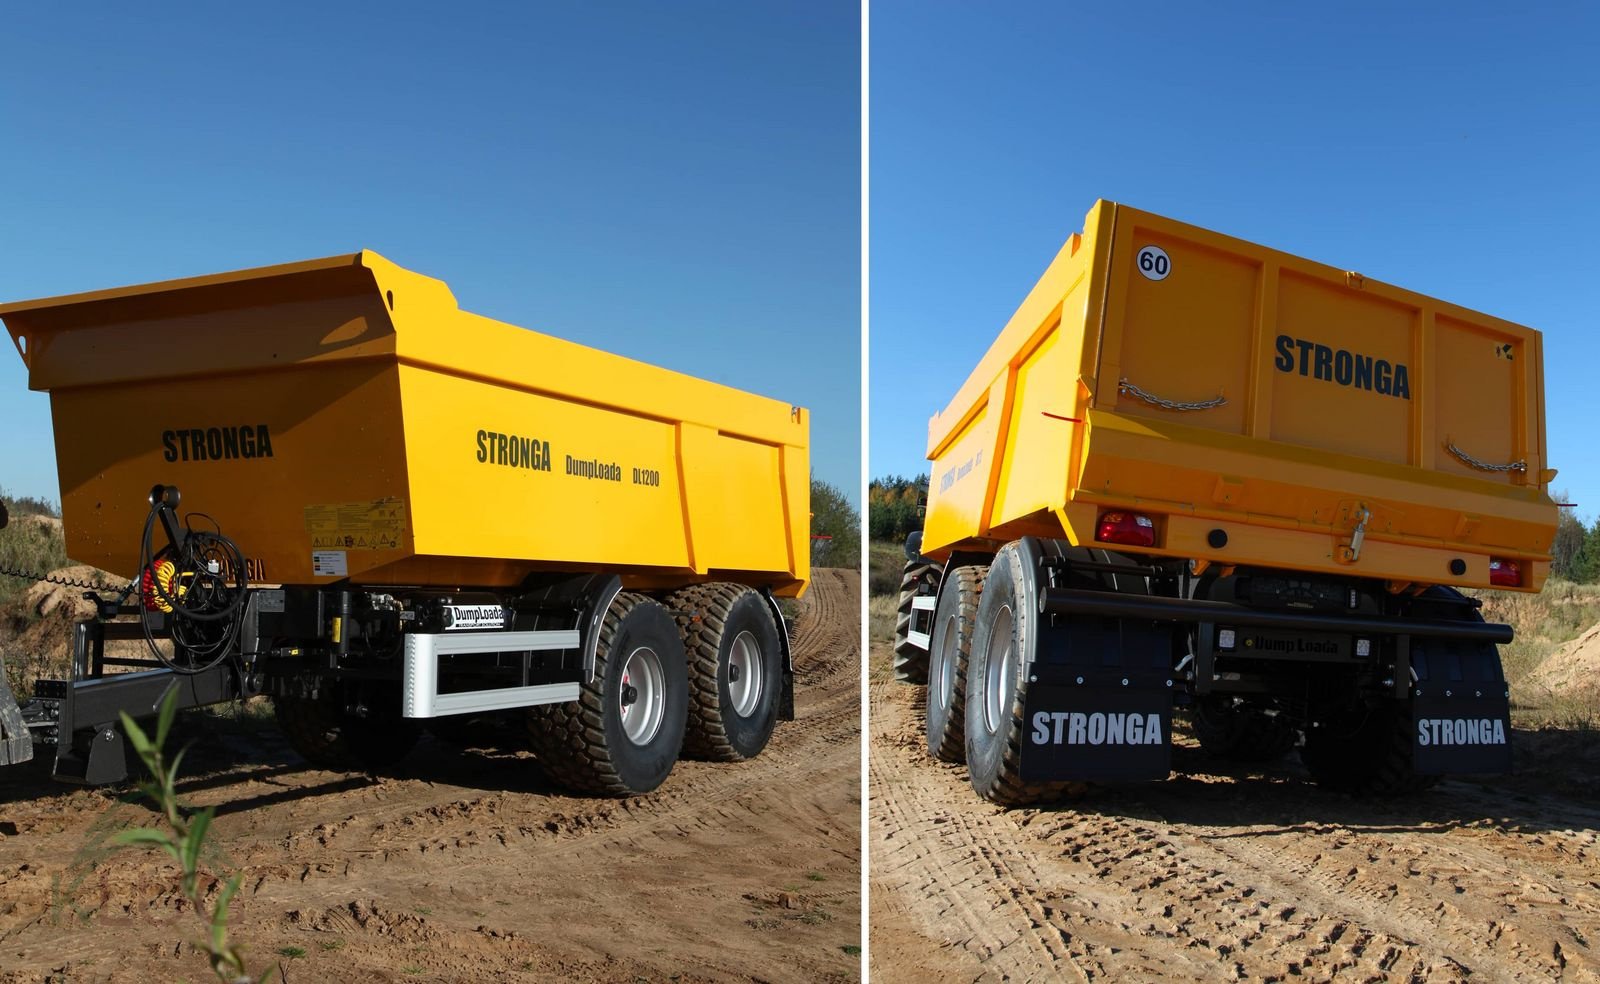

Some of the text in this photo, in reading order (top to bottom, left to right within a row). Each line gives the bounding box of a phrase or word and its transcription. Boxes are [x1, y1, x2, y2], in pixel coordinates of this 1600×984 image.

[1139, 251, 1168, 275] 60
[1275, 335, 1410, 400] STRONGA
[162, 424, 273, 463] STRONGA
[476, 429, 660, 487] STRONGA DumpLoada DL1200
[454, 607, 503, 623] DumpLoada
[1255, 635, 1338, 654] Dump Loada
[1031, 711, 1162, 745] STRONGA
[1418, 718, 1506, 746] STRONGA
